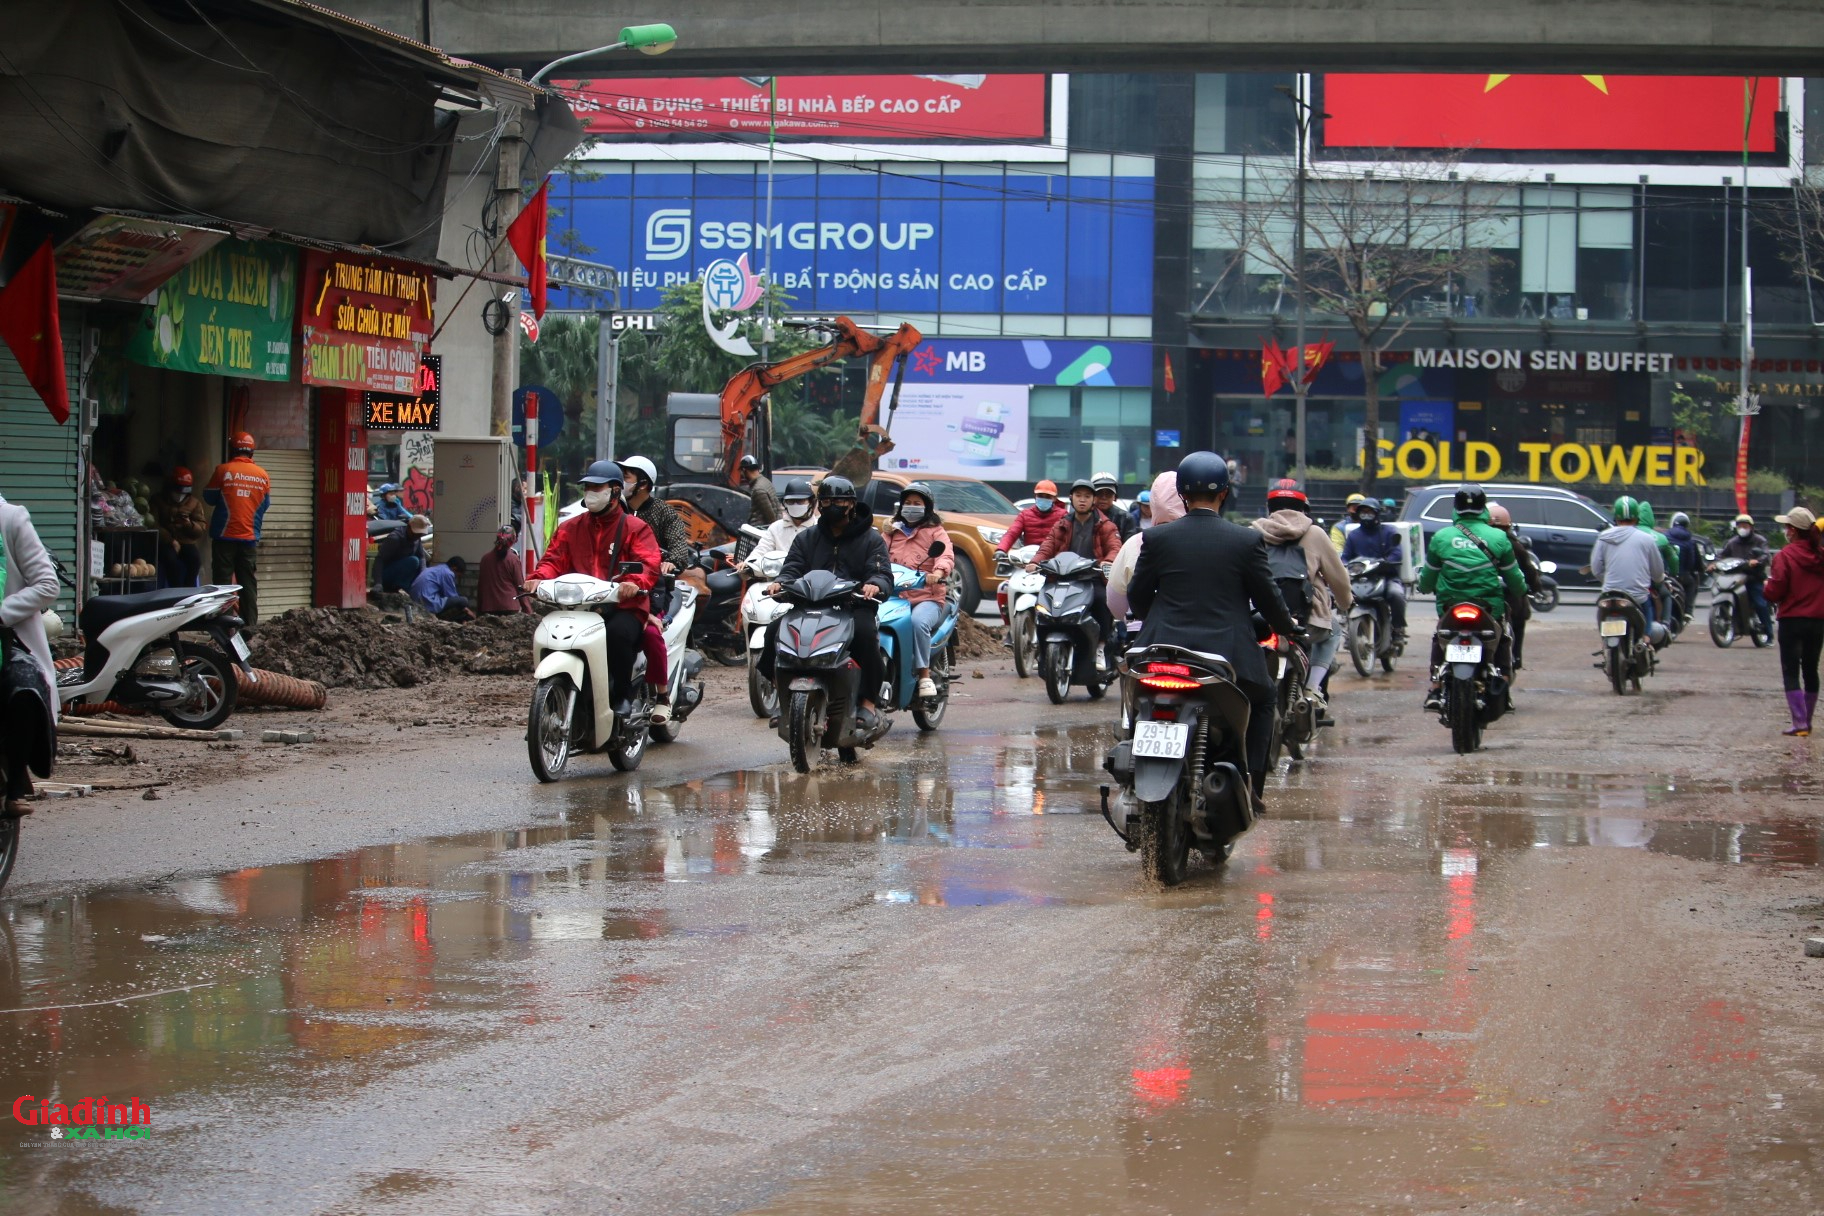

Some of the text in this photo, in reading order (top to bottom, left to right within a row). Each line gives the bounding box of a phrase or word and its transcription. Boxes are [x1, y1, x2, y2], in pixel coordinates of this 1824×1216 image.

[617, 98, 648, 112] GIA
[653, 98, 704, 116] DỤNG
[720, 93, 770, 113] THIẾT
[776, 98, 793, 116] BỊ
[798, 95, 837, 113] NHÀ
[842, 95, 875, 113] BẾP
[880, 99, 919, 113] CAO
[924, 95, 961, 113] CẤP
[335, 262, 364, 291] TRUNG
[365, 262, 382, 294] TÂM
[396, 271, 420, 306] THUẬT
[834, 269, 893, 293] ĐỘNG
[899, 268, 939, 290] SẢN
[949, 273, 994, 290] CAO
[1004, 268, 1047, 291] CẤP
[338, 297, 411, 340] SỬA CHỮA XE MÁY
[198, 306, 252, 369] BẾN TRE
[311, 335, 340, 380] GIẢM
[341, 342, 366, 383] 10%
[367, 341, 387, 370] TIỀN
[389, 345, 416, 374] CÔNG
[946, 351, 986, 372] MB
[1413, 348, 1674, 373] MAISON SEN BUFFET
[371, 402, 393, 423] XE
[398, 398, 435, 424] MÁY
[348, 447, 366, 471] SUZUKI
[1360, 440, 1501, 481] GOLD
[1519, 442, 1706, 486] TOWER
[1143, 725, 1179, 740] 29-L1
[1136, 740, 1182, 756] 978.82
